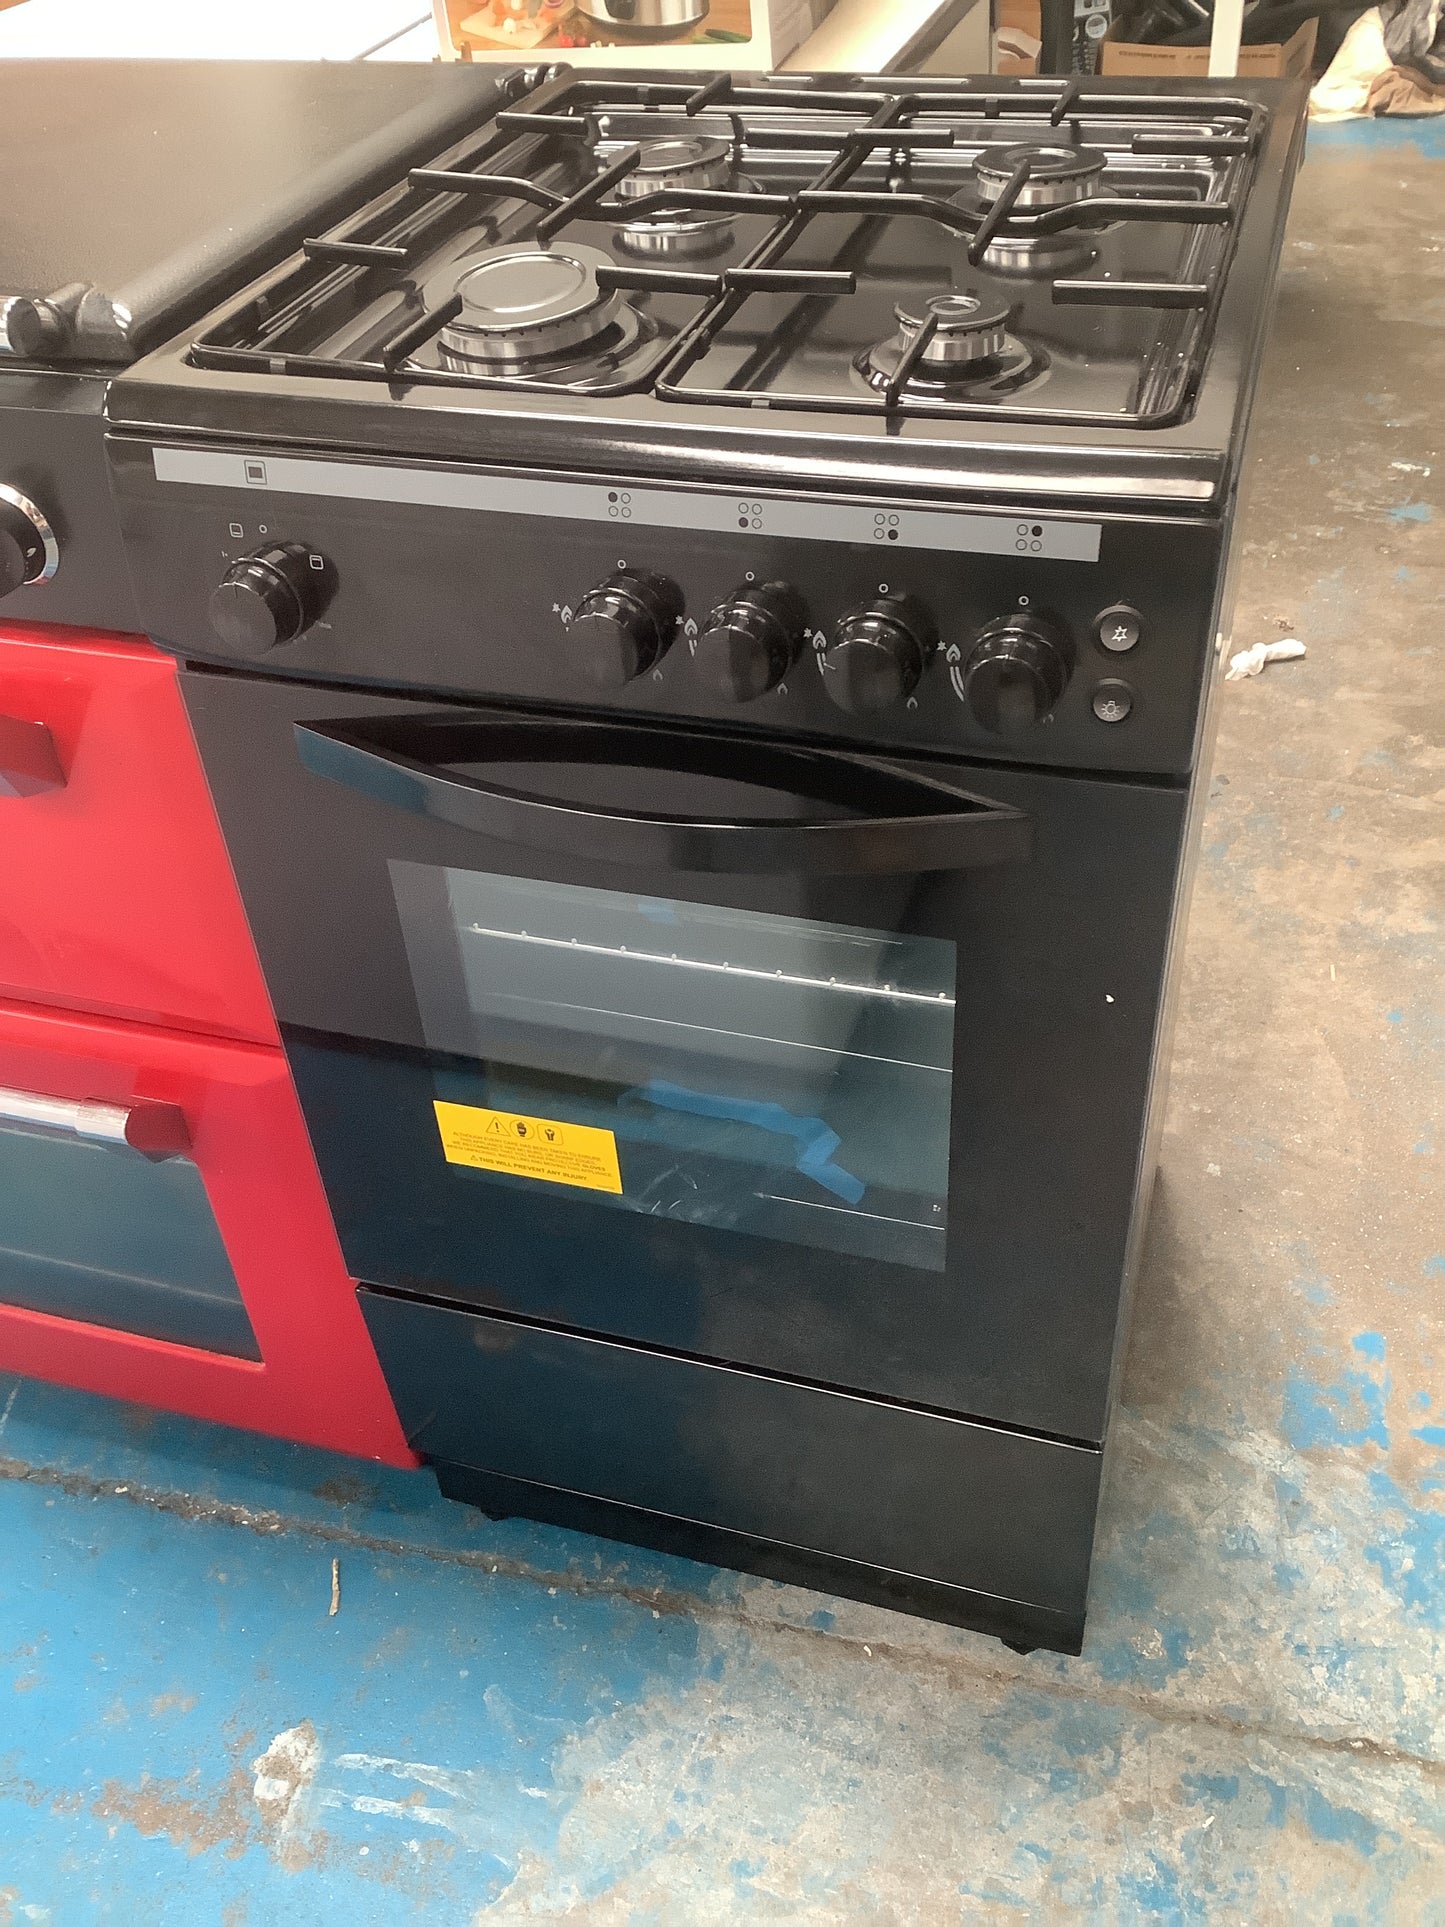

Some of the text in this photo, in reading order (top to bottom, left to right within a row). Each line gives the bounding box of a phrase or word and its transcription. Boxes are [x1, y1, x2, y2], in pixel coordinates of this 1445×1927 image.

[495, 1159, 512, 1167] WILL
[512, 1162, 545, 1173] PREVENT
[562, 1171, 587, 1180] INJURY
